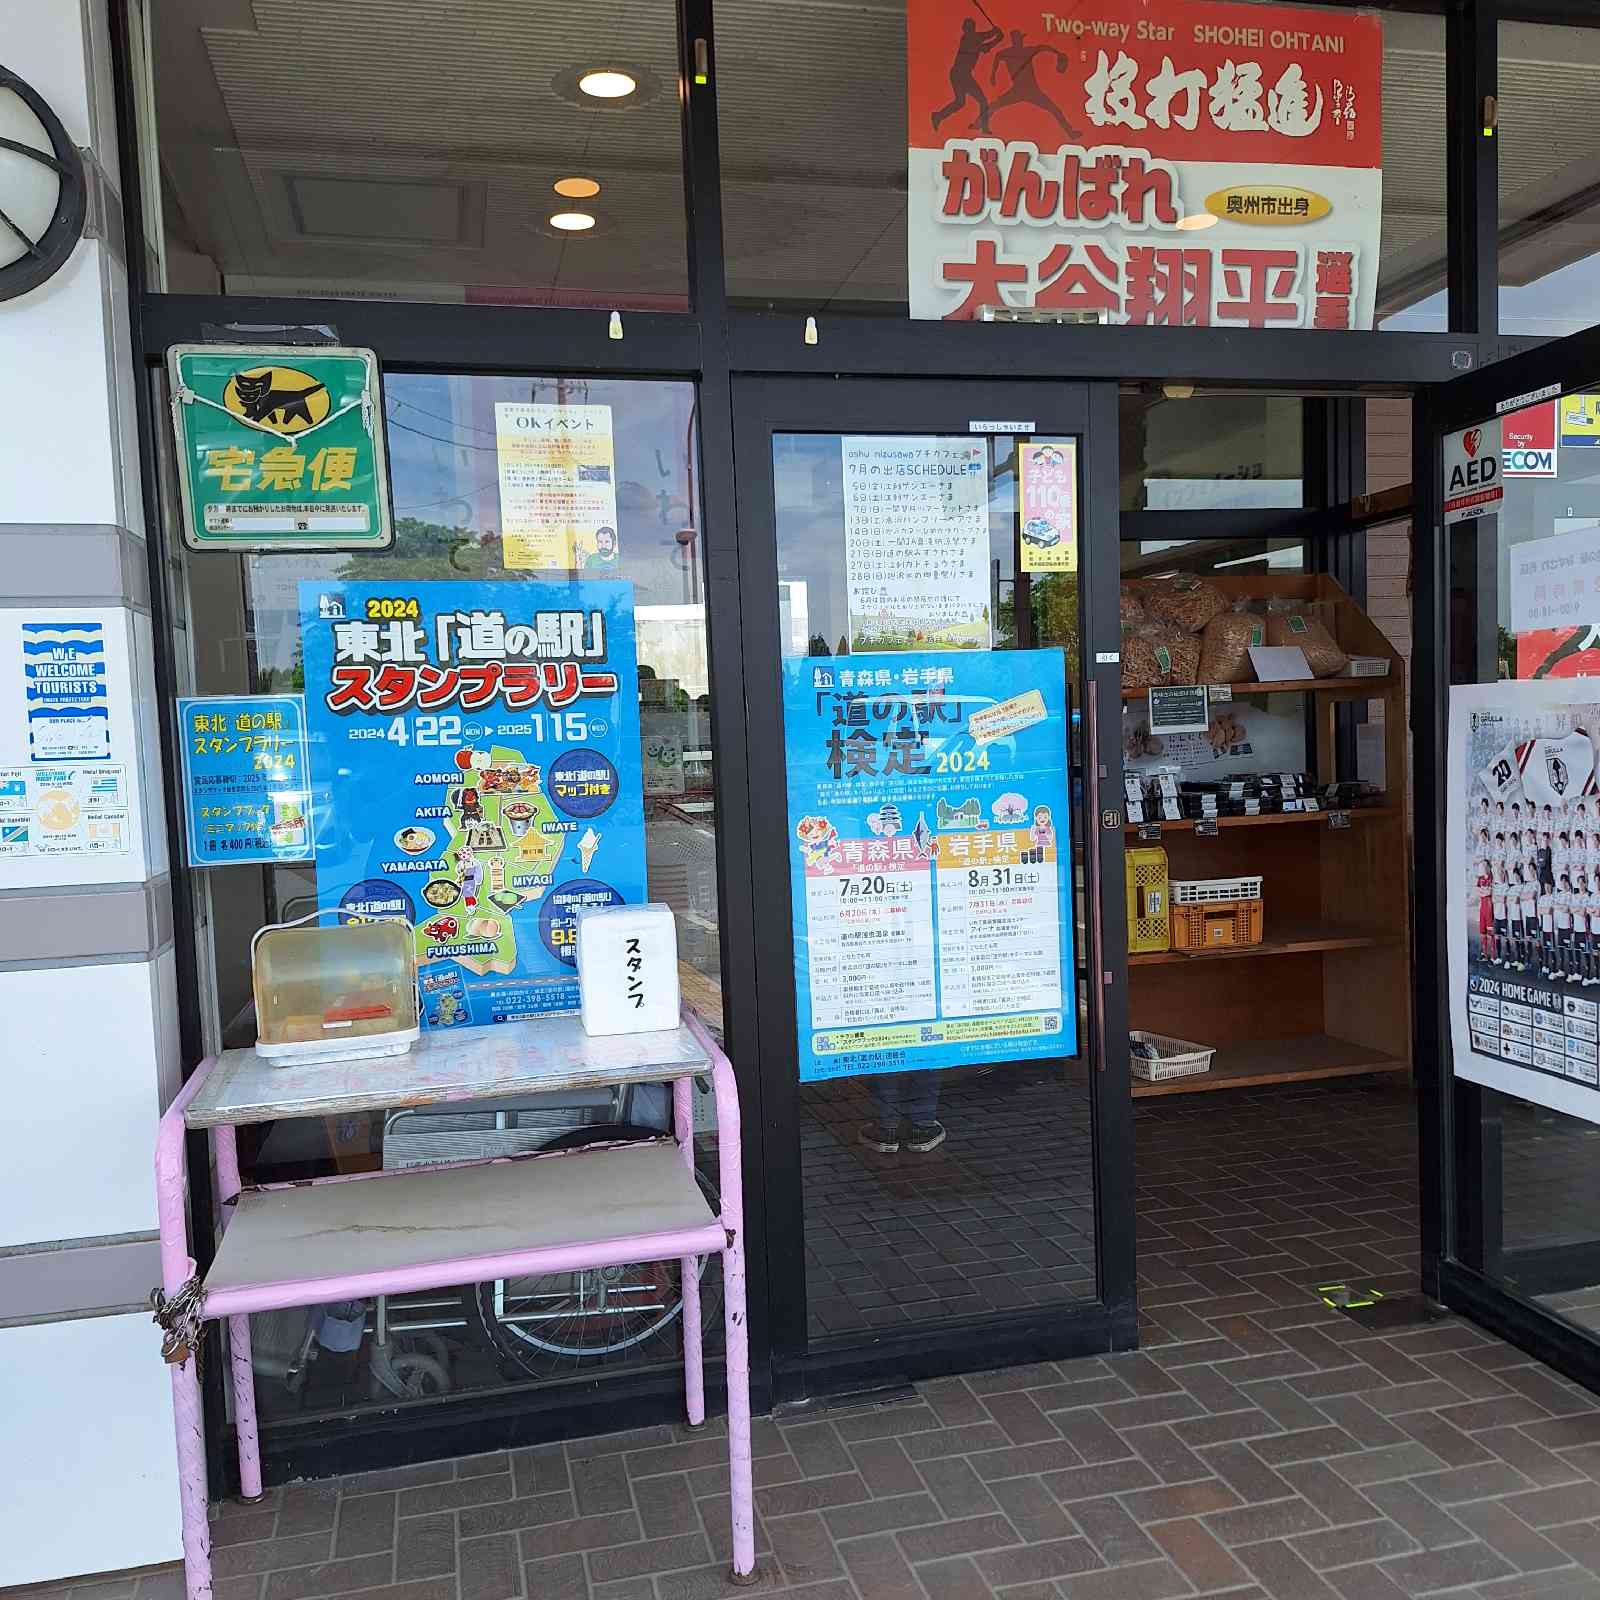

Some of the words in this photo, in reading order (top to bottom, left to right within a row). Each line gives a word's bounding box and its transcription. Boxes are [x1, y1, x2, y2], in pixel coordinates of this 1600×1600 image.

[1041, 13, 1130, 43] Two-way
[1136, 21, 1175, 41] Star
[1193, 25, 1264, 48] SHOHEI
[1270, 30, 1345, 54] OHTANI
[1083, 50, 1324, 137] 投打猛進
[942, 147, 1178, 224] がんばれ
[1226, 194, 1311, 218] 奥州市出身
[1508, 432, 1534, 441] Security
[1517, 440, 1525, 448] by
[206, 447, 358, 491] 宅急便
[1449, 456, 1498, 492] AED
[367, 599, 419, 618] 2024
[334, 611, 605, 663] 東北「道の駅」
[52, 647, 76, 661] WE
[35, 663, 97, 677] WELCOME
[839, 667, 954, 687] 青森県・岩手県
[35, 680, 97, 694] TOURISTS
[328, 661, 618, 709] スタンプラリー
[816, 689, 962, 728] 「道の駅」
[194, 713, 227, 733] 東北
[236, 711, 282, 731] 道の駅
[349, 728, 386, 740] 2024
[387, 717, 410, 747] 4
[415, 715, 462, 746] 22
[497, 725, 533, 736] 2025
[531, 713, 545, 742] 1
[550, 712, 588, 741] 15
[253, 753, 296, 770] 2024
[826, 727, 931, 780] 検定
[936, 751, 990, 773] 2024
[413, 773, 463, 784] AOMORI
[415, 806, 452, 819] AKITA
[542, 822, 577, 832] IWATE
[843, 838, 915, 863] 青森県
[948, 832, 1018, 856] 岩手県
[381, 859, 448, 872] YAMAGATA
[512, 874, 553, 887] MIYAGI
[839, 875, 913, 897] 7月20日(土)
[968, 867, 1040, 888] 8月31日(土)
[427, 943, 498, 958] FUKUSHIMA
[625, 938, 645, 1009] スタンプ
[1479, 978, 1500, 997] 2024
[1501, 982, 1527, 1001] HOME
[1527, 987, 1552, 1008] GAME
